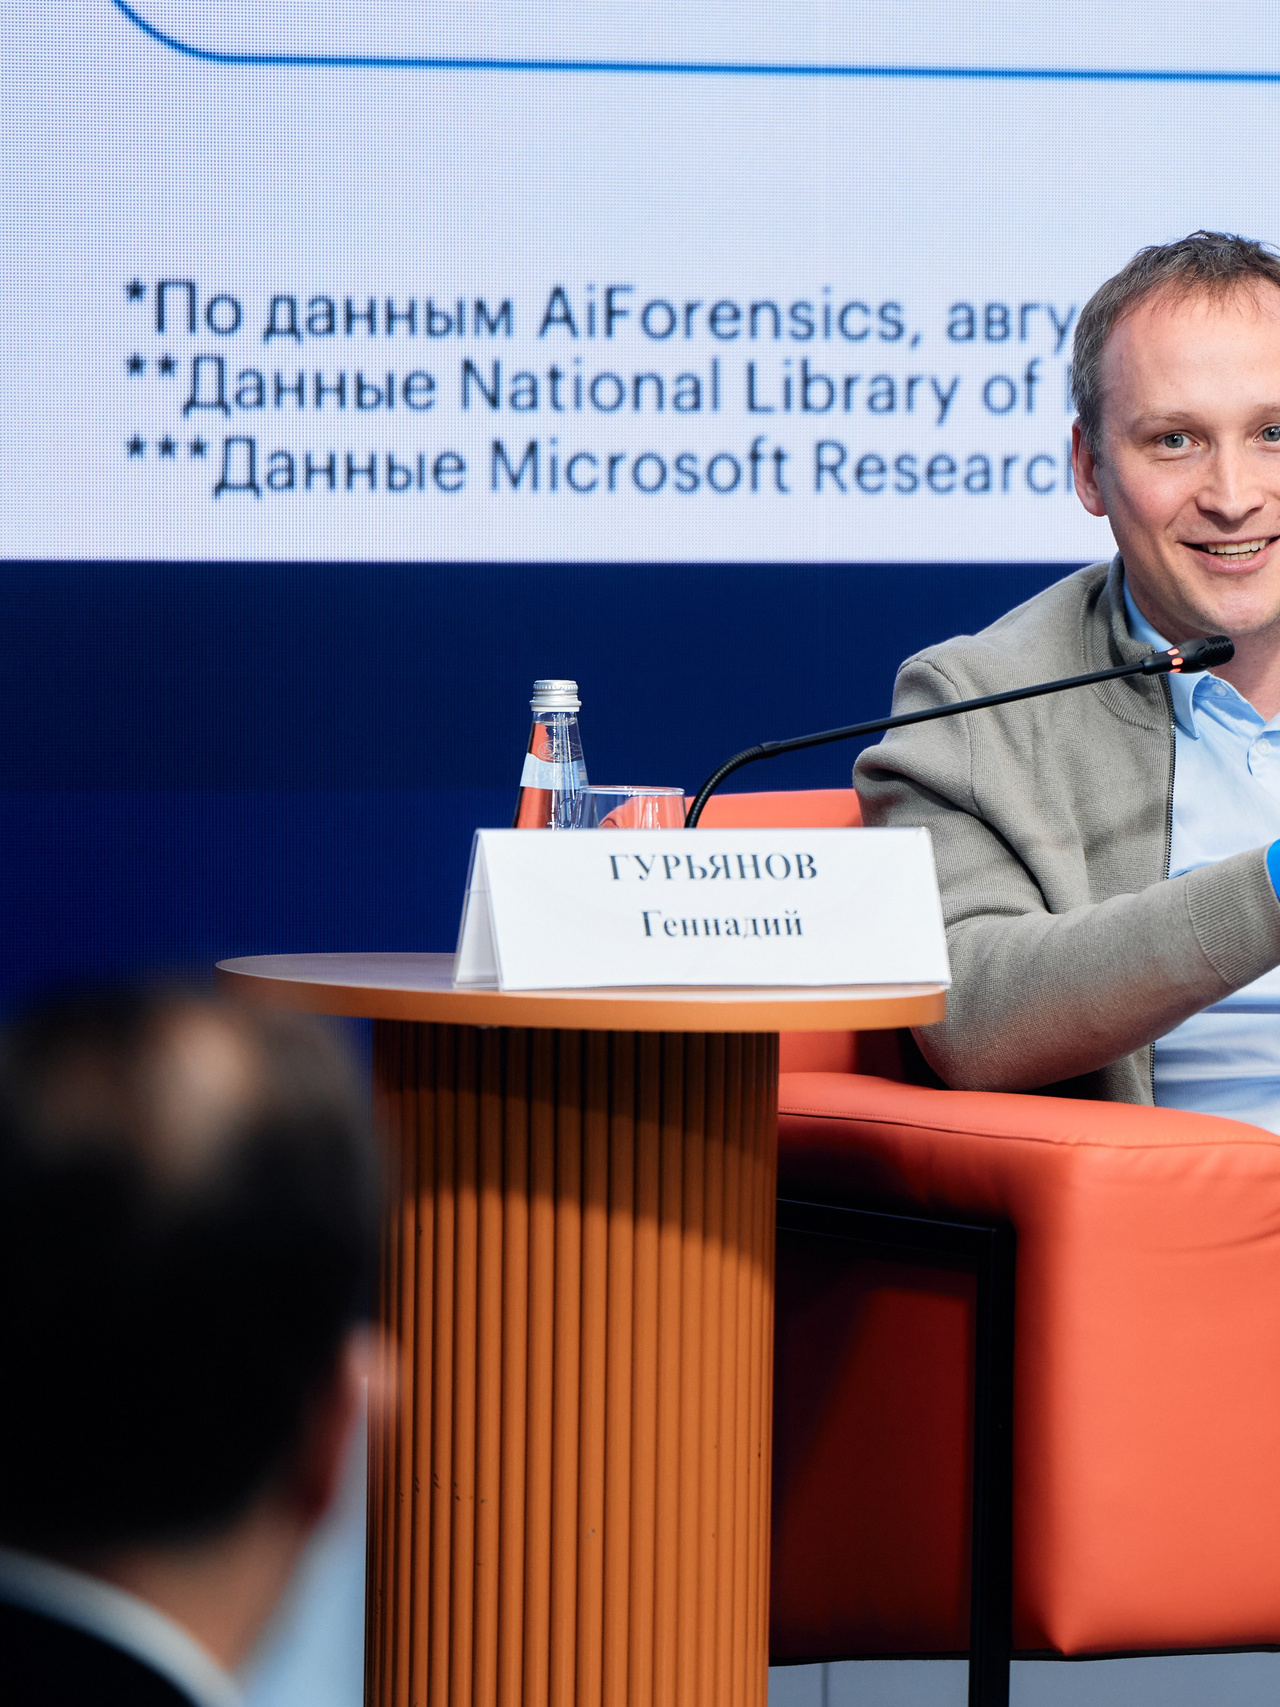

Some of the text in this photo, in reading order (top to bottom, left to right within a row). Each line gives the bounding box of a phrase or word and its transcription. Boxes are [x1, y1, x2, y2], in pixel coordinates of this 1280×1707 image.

[262, 294, 514, 343] данным
[538, 284, 922, 348] AiForensics,
[946, 301, 1077, 356] авгу
[460, 357, 720, 413] National
[746, 357, 960, 426] Library
[982, 357, 1040, 415] of
[490, 435, 790, 494] Microsoft
[609, 852, 818, 881] ГУРЬЯНОВ
[641, 909, 804, 940] Геннадий
